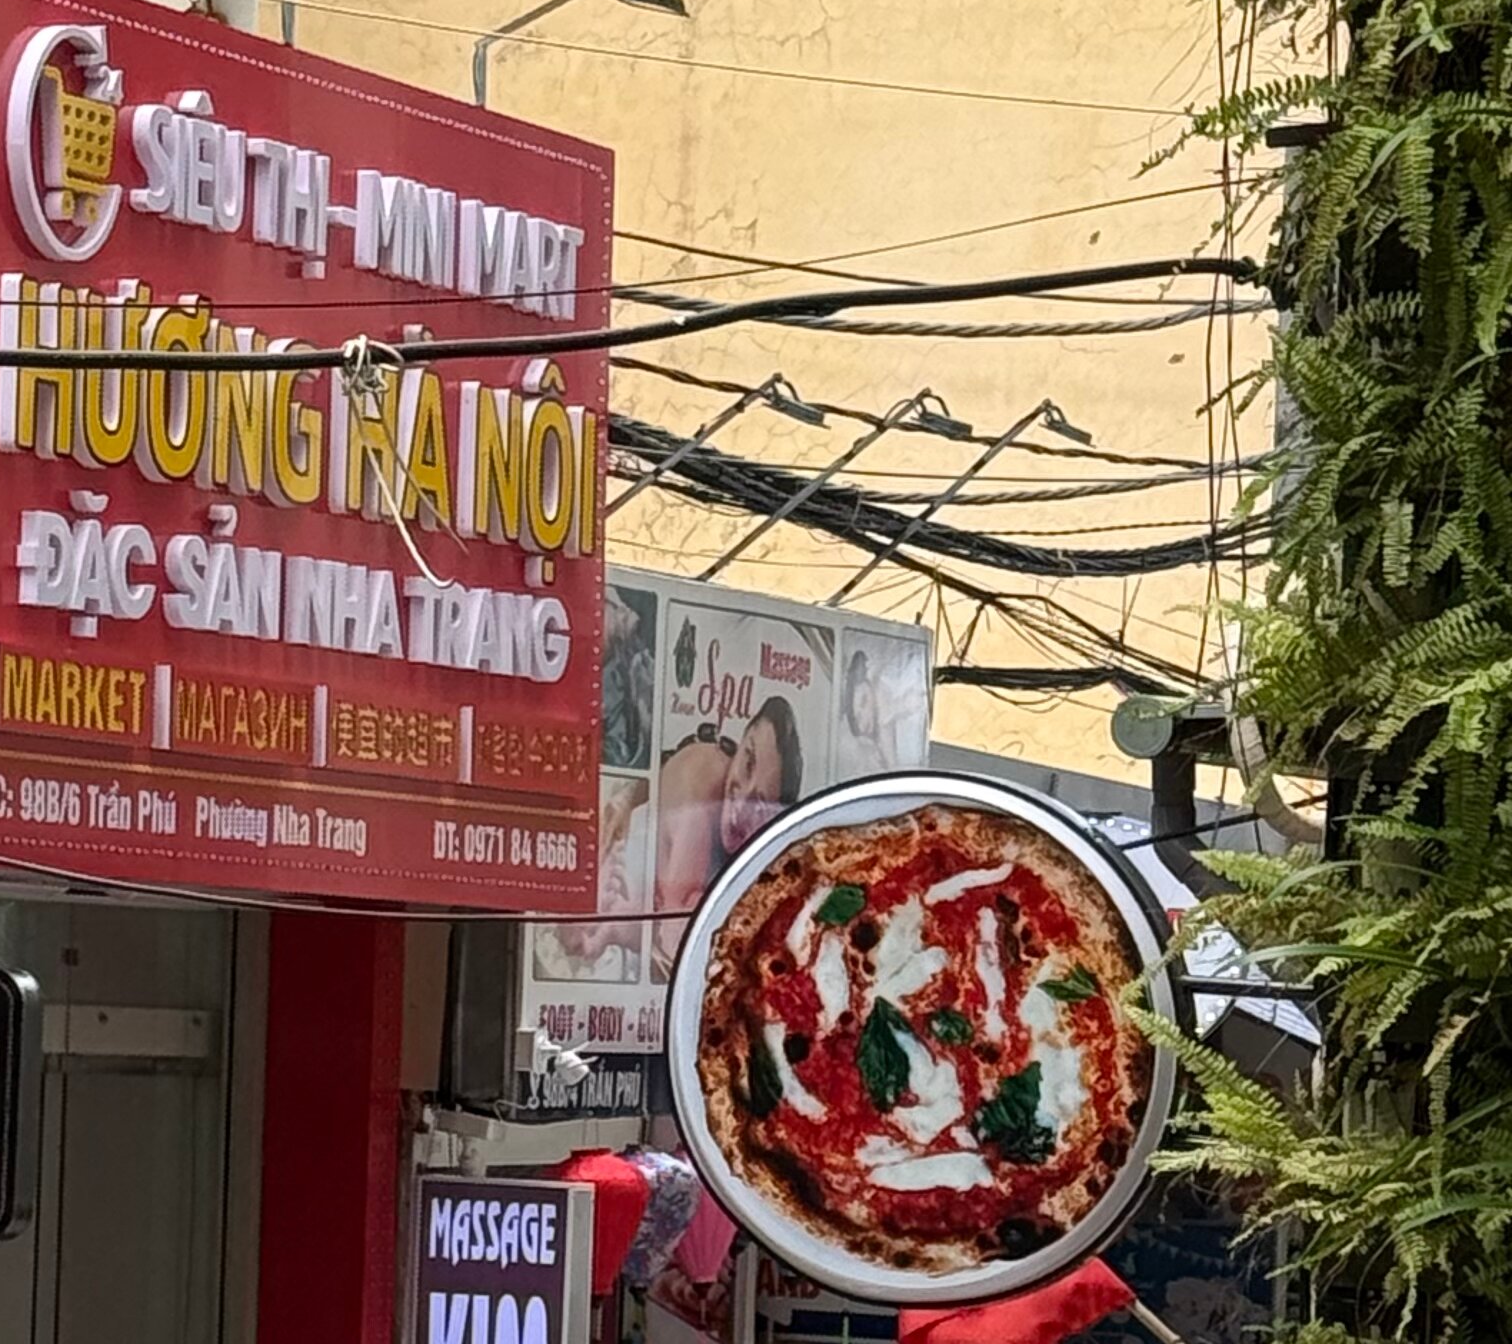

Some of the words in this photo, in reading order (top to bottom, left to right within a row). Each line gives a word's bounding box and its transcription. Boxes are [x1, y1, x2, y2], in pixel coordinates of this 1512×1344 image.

[129, 90, 248, 233] SIÊU
[247, 137, 331, 280] THỊ
[458, 198, 585, 322] MART
[458, 358, 598, 588] NỘI
[17, 490, 157, 638] ĐẶC
[164, 504, 283, 641] SẢN
[286, 555, 405, 660] NHA
[403, 575, 571, 683] TRANG
[3, 653, 146, 736] MARKET
[176, 677, 308, 755] МАГАЗИН
[138, 790, 177, 835] Phú
[272, 804, 311, 847] Nha
[315, 808, 368, 858] Trang
[510, 828, 532, 869] 84
[428, 1197, 557, 1269] MASSAGE
